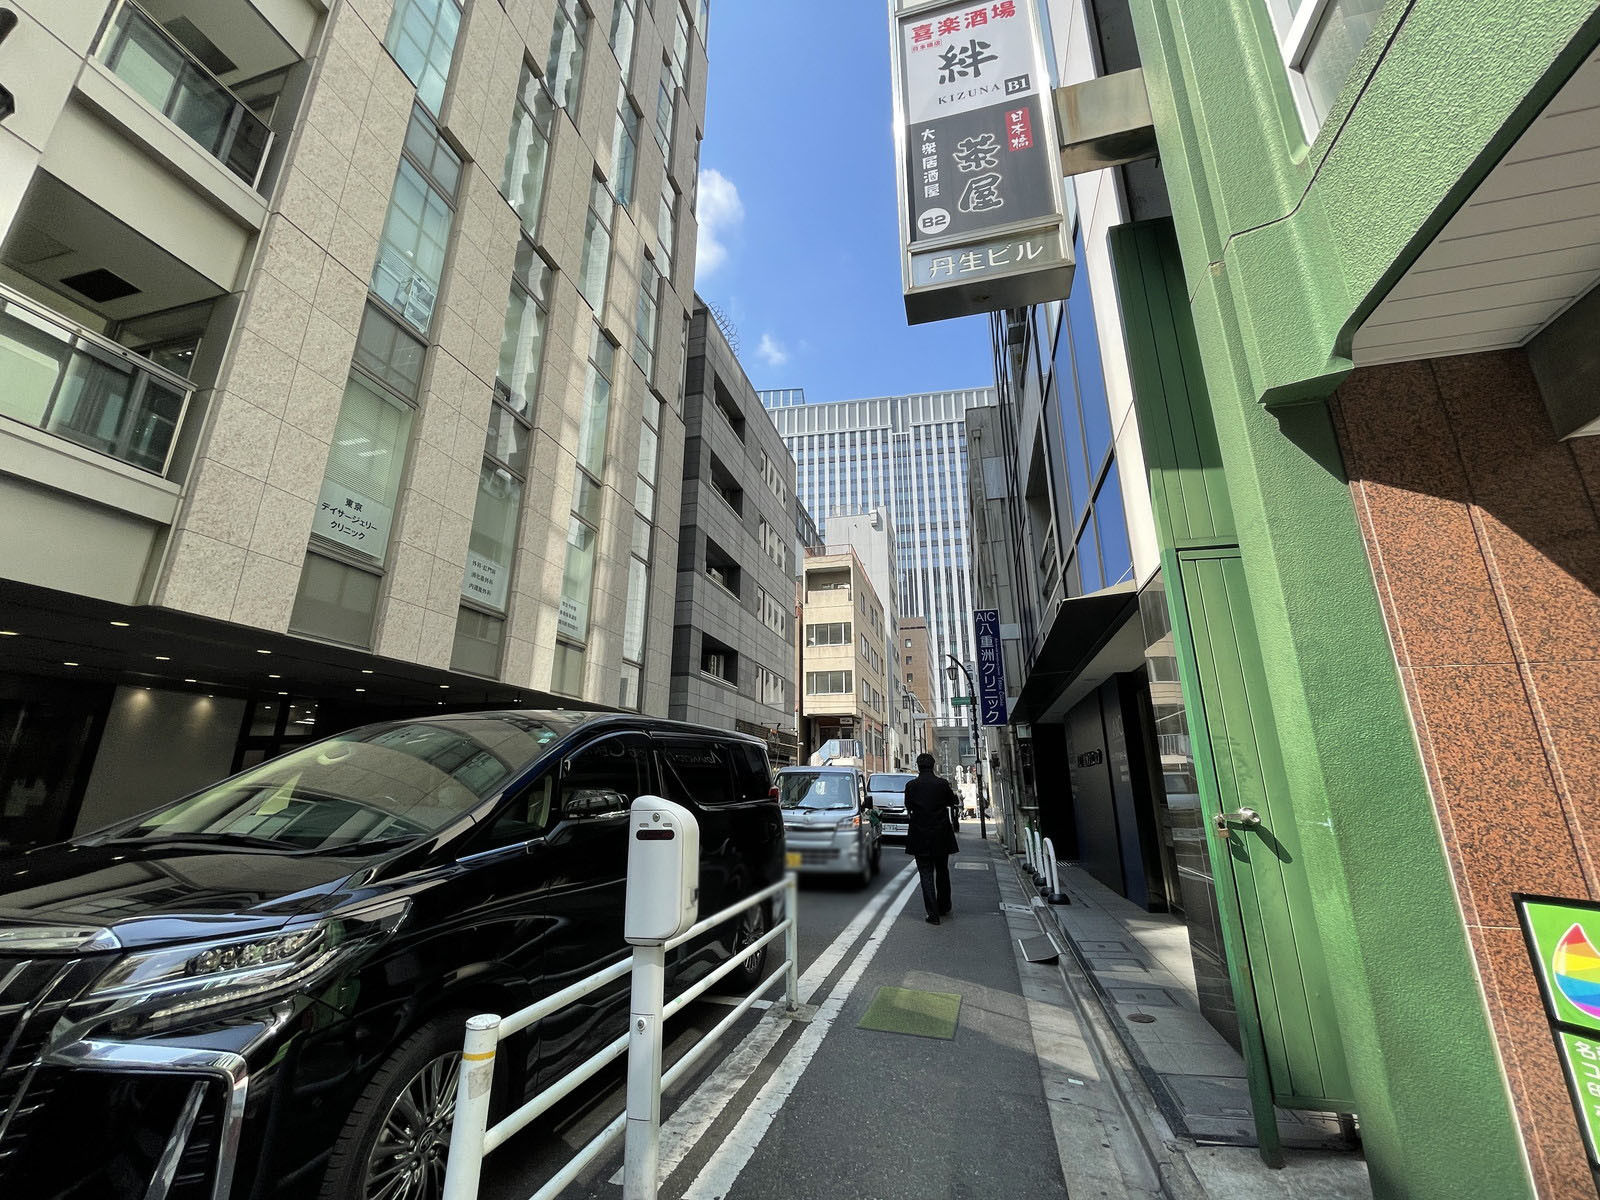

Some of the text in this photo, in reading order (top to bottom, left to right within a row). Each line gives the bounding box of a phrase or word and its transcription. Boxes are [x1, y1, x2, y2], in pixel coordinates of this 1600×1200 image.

[911, 1, 1016, 43] 喜楽酒場
[938, 39, 998, 84] 絆
[938, 83, 1000, 104] KIZUNA
[1007, 77, 1028, 92] B1
[1011, 110, 1029, 150] 日本橋
[921, 128, 940, 198] 大衆居酒屋
[922, 214, 947, 228] B2
[929, 241, 1043, 278] 丹生ビル
[345, 498, 363, 512] 東京
[330, 520, 366, 540] クリニック
[975, 611, 996, 622] AIC
[979, 623, 999, 723] 八重洲クリニック
